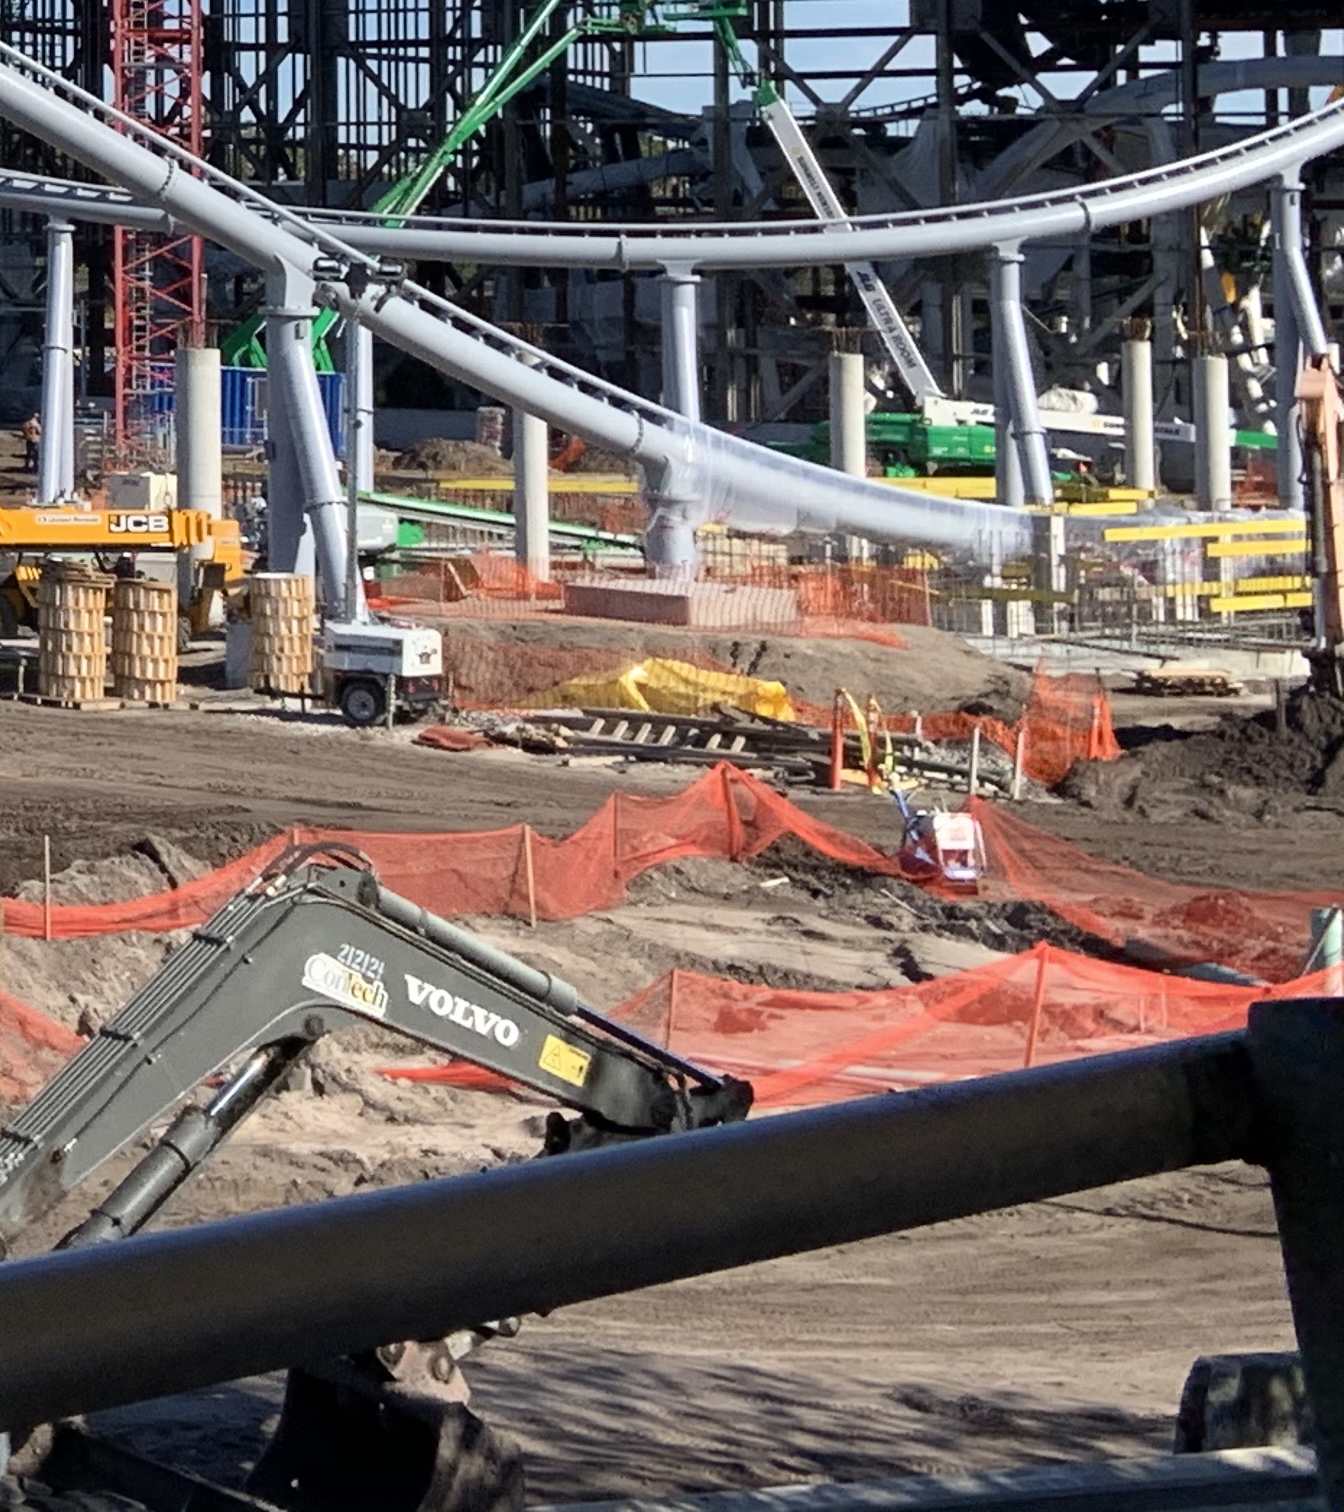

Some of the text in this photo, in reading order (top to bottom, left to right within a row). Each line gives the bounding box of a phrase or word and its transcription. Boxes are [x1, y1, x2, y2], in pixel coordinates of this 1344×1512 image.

[872, 298, 896, 333] ULTRA
[110, 515, 169, 532] JCB
[404, 973, 520, 1047] VOLVO
